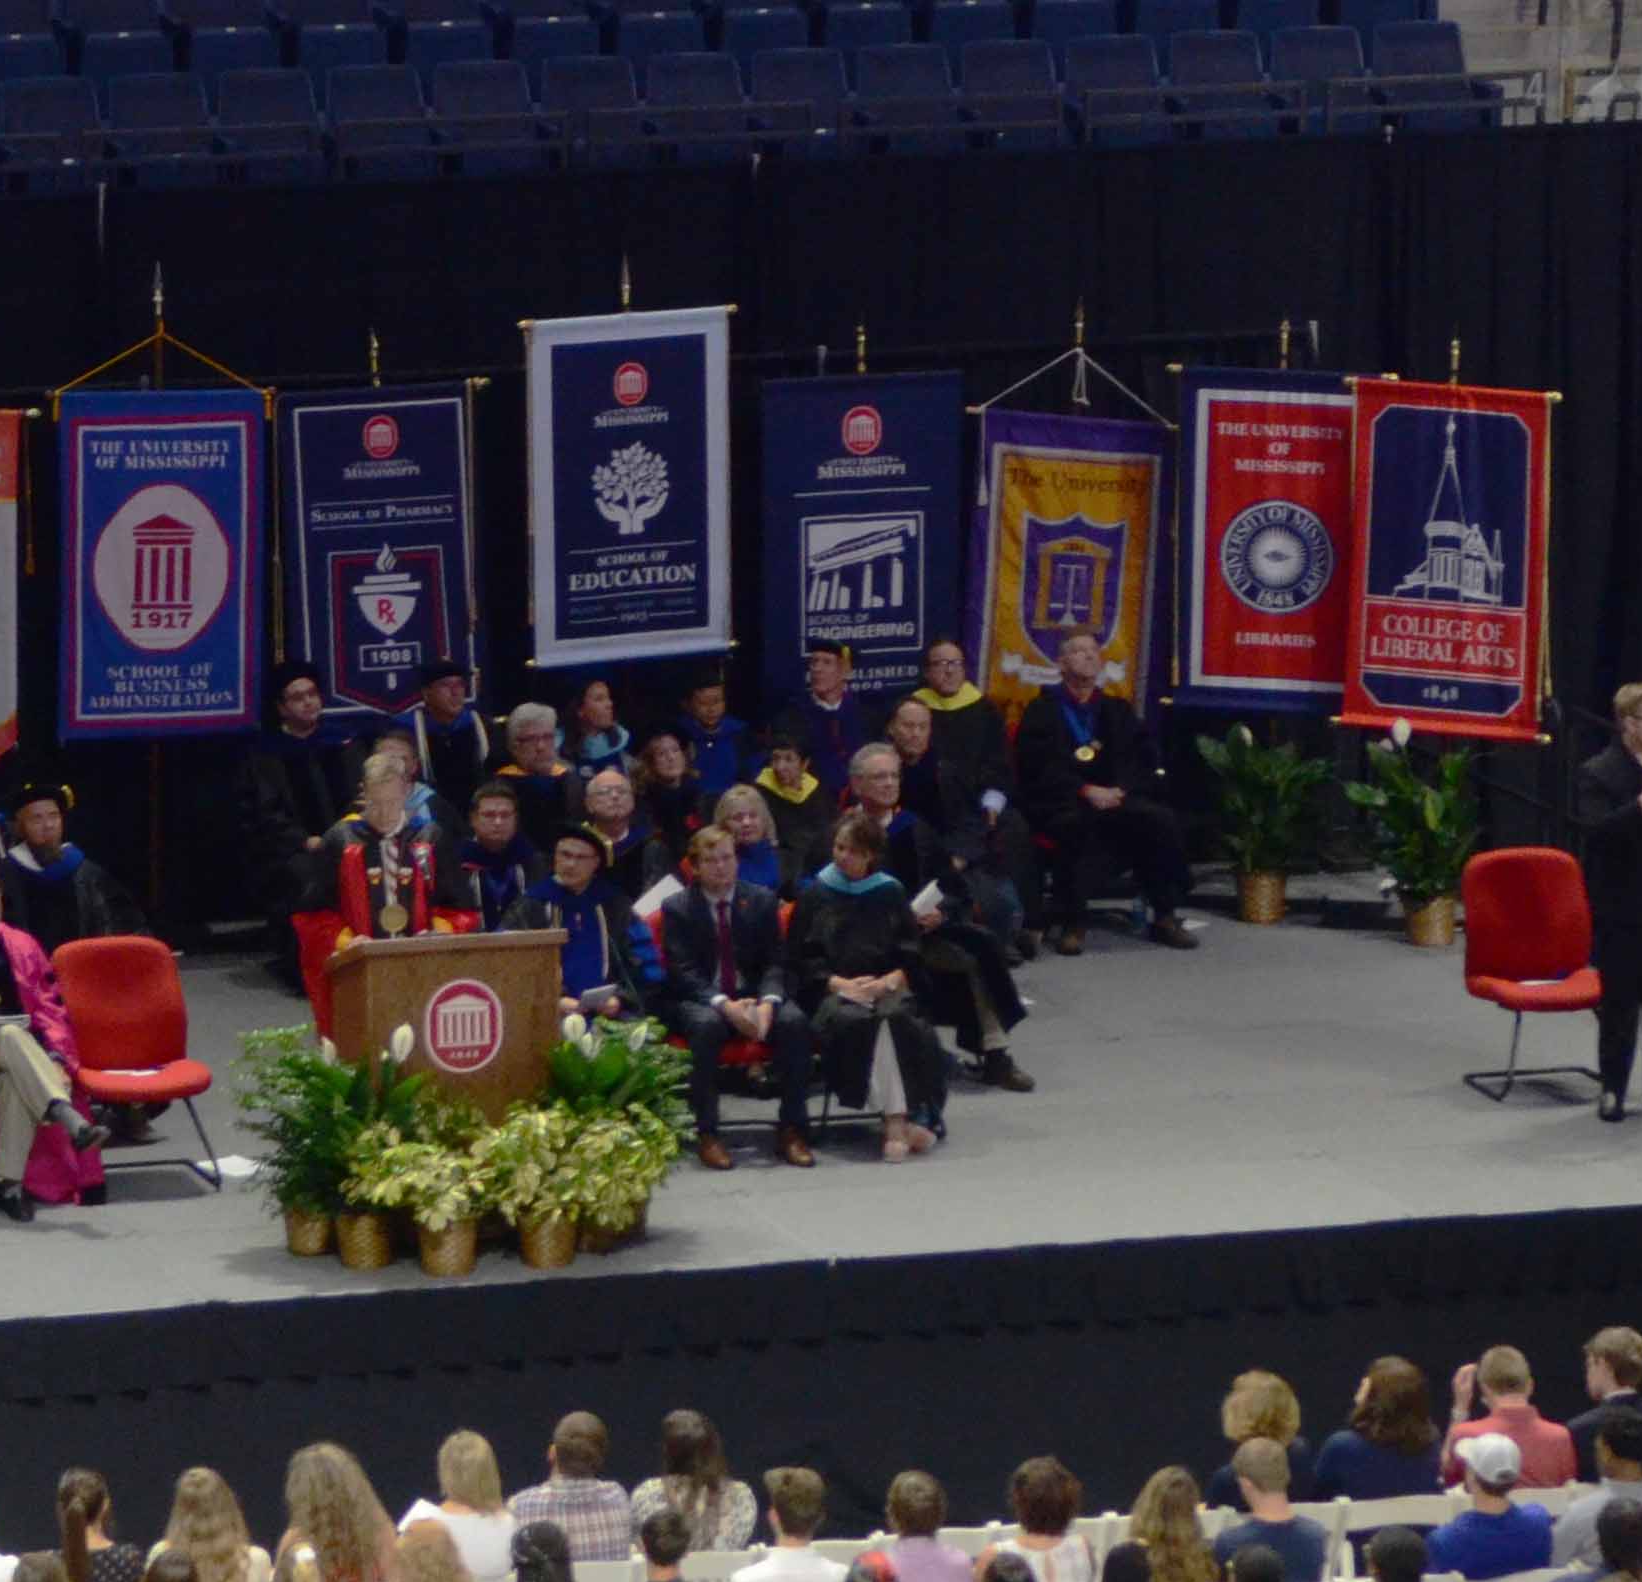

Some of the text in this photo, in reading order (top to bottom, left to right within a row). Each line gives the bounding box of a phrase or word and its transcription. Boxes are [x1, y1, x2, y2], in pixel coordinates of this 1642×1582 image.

[1217, 422, 1343, 440] THE UNIVERSITY
[89, 439, 230, 454] THE UNIVERSITY
[1268, 442, 1292, 455] OF
[95, 455, 226, 469] OF MISSISSIPPI
[1234, 459, 1325, 475] MISSISSIPPI
[1268, 506, 1289, 521] OF
[596, 550, 669, 567] SCHOOL OF
[569, 563, 697, 591] EDUCATION
[132, 611, 193, 629] 1917
[808, 621, 916, 640] ENGINEERING
[1382, 614, 1504, 643] COLLEGE OF
[1235, 632, 1316, 648] LIBRARIES
[372, 648, 412, 664] 1908
[1371, 636, 1516, 669] LIBERAL ARTS
[108, 662, 214, 680] SCHOOL OF
[114, 679, 209, 693] BUSINESS
[1421, 685, 1459, 701] 1848
[89, 690, 233, 708] ADMINISTRATION
